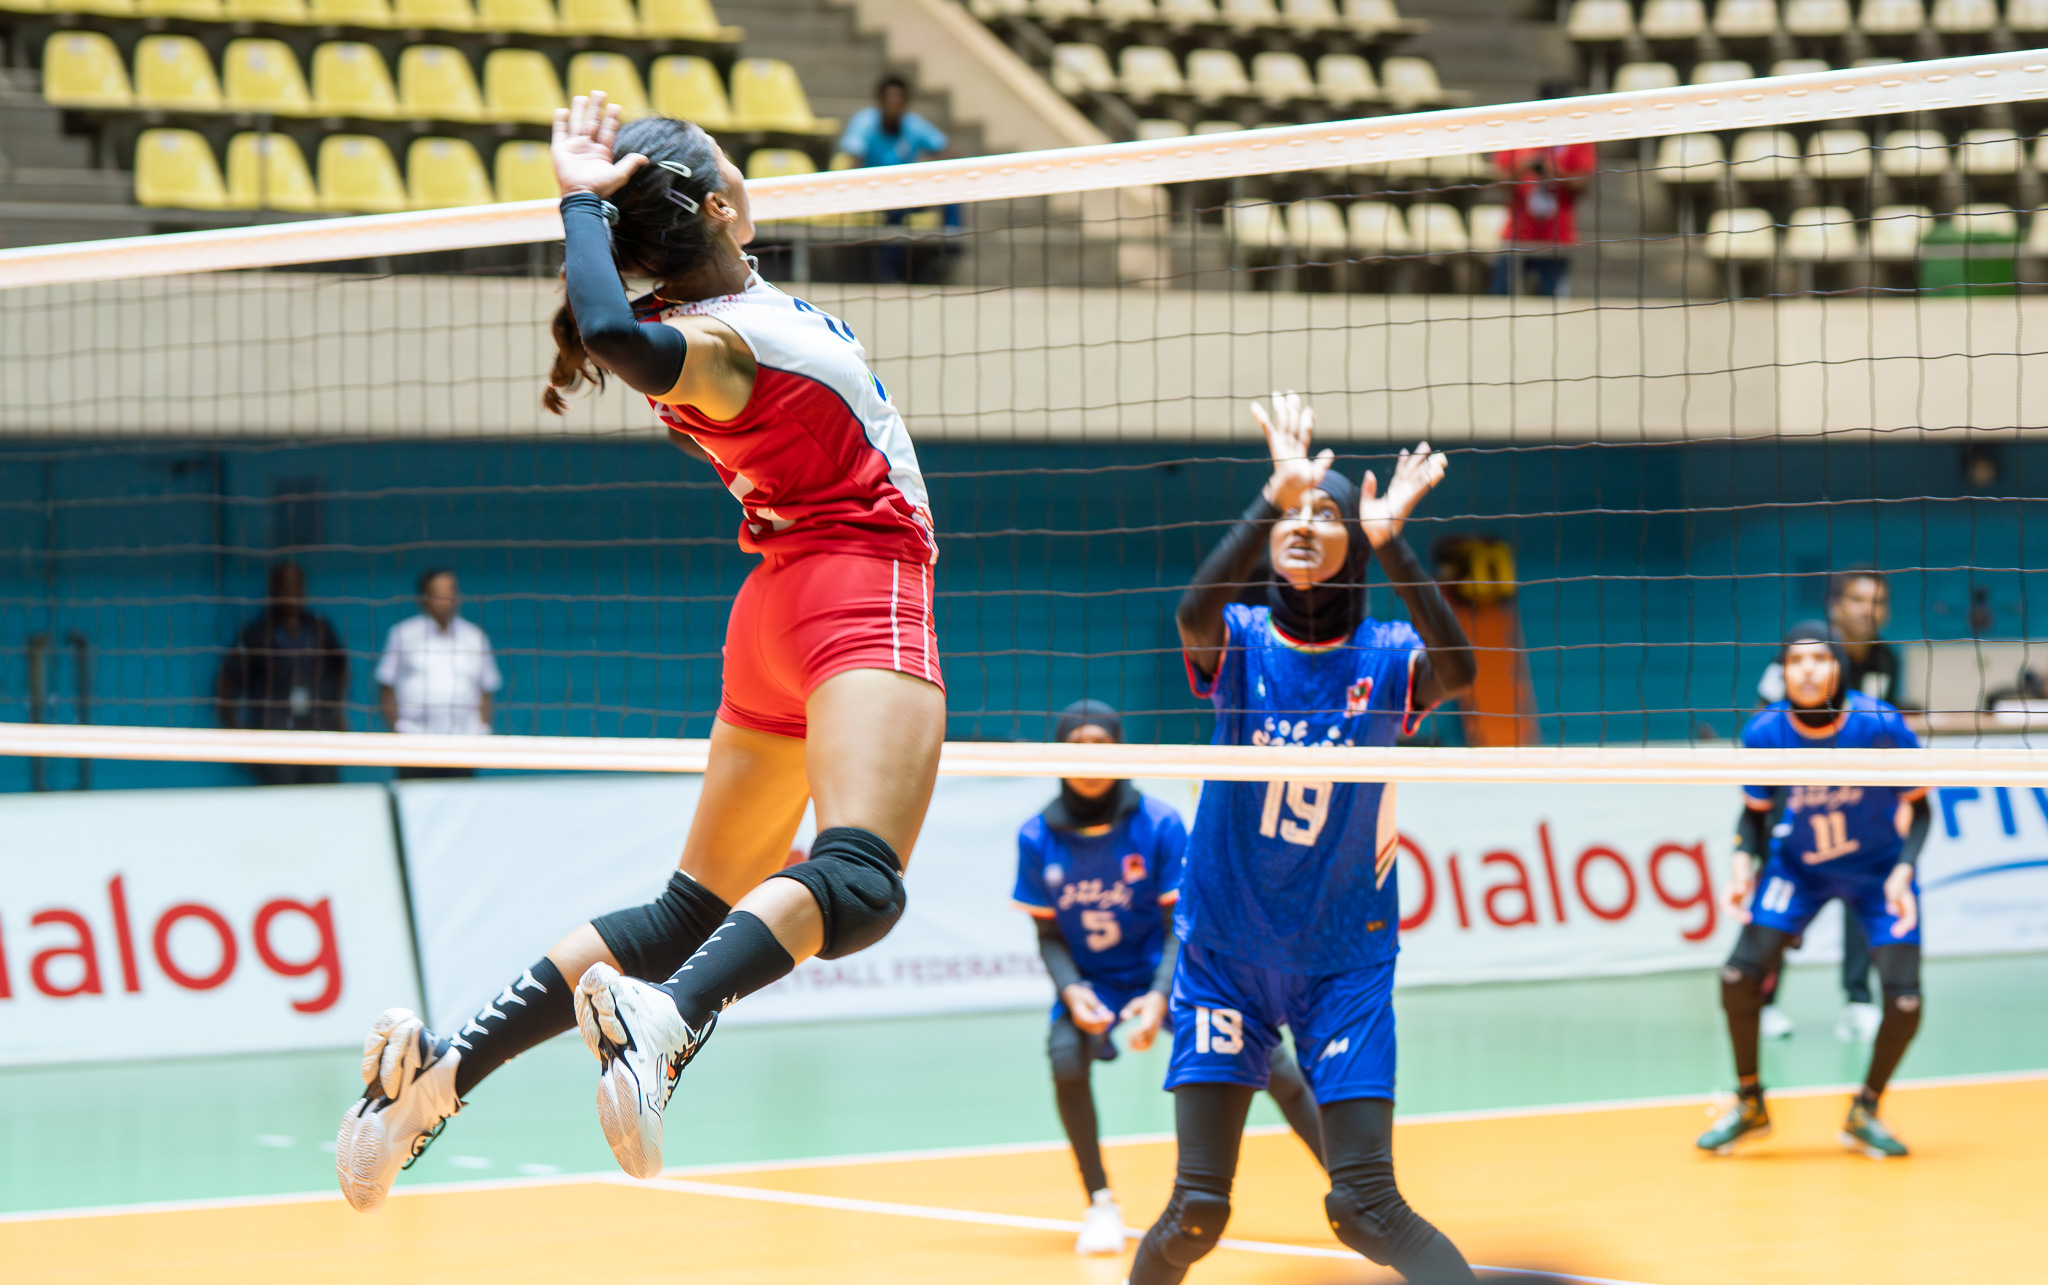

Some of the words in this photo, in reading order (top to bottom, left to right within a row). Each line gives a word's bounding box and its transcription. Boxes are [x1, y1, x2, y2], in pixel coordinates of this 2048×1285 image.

[1258, 781, 1334, 847] 19
[1937, 787, 2048, 838] FI
[1802, 811, 1861, 866] 11
[1080, 909, 1122, 953] 5
[1195, 1006, 1244, 1055] 19
